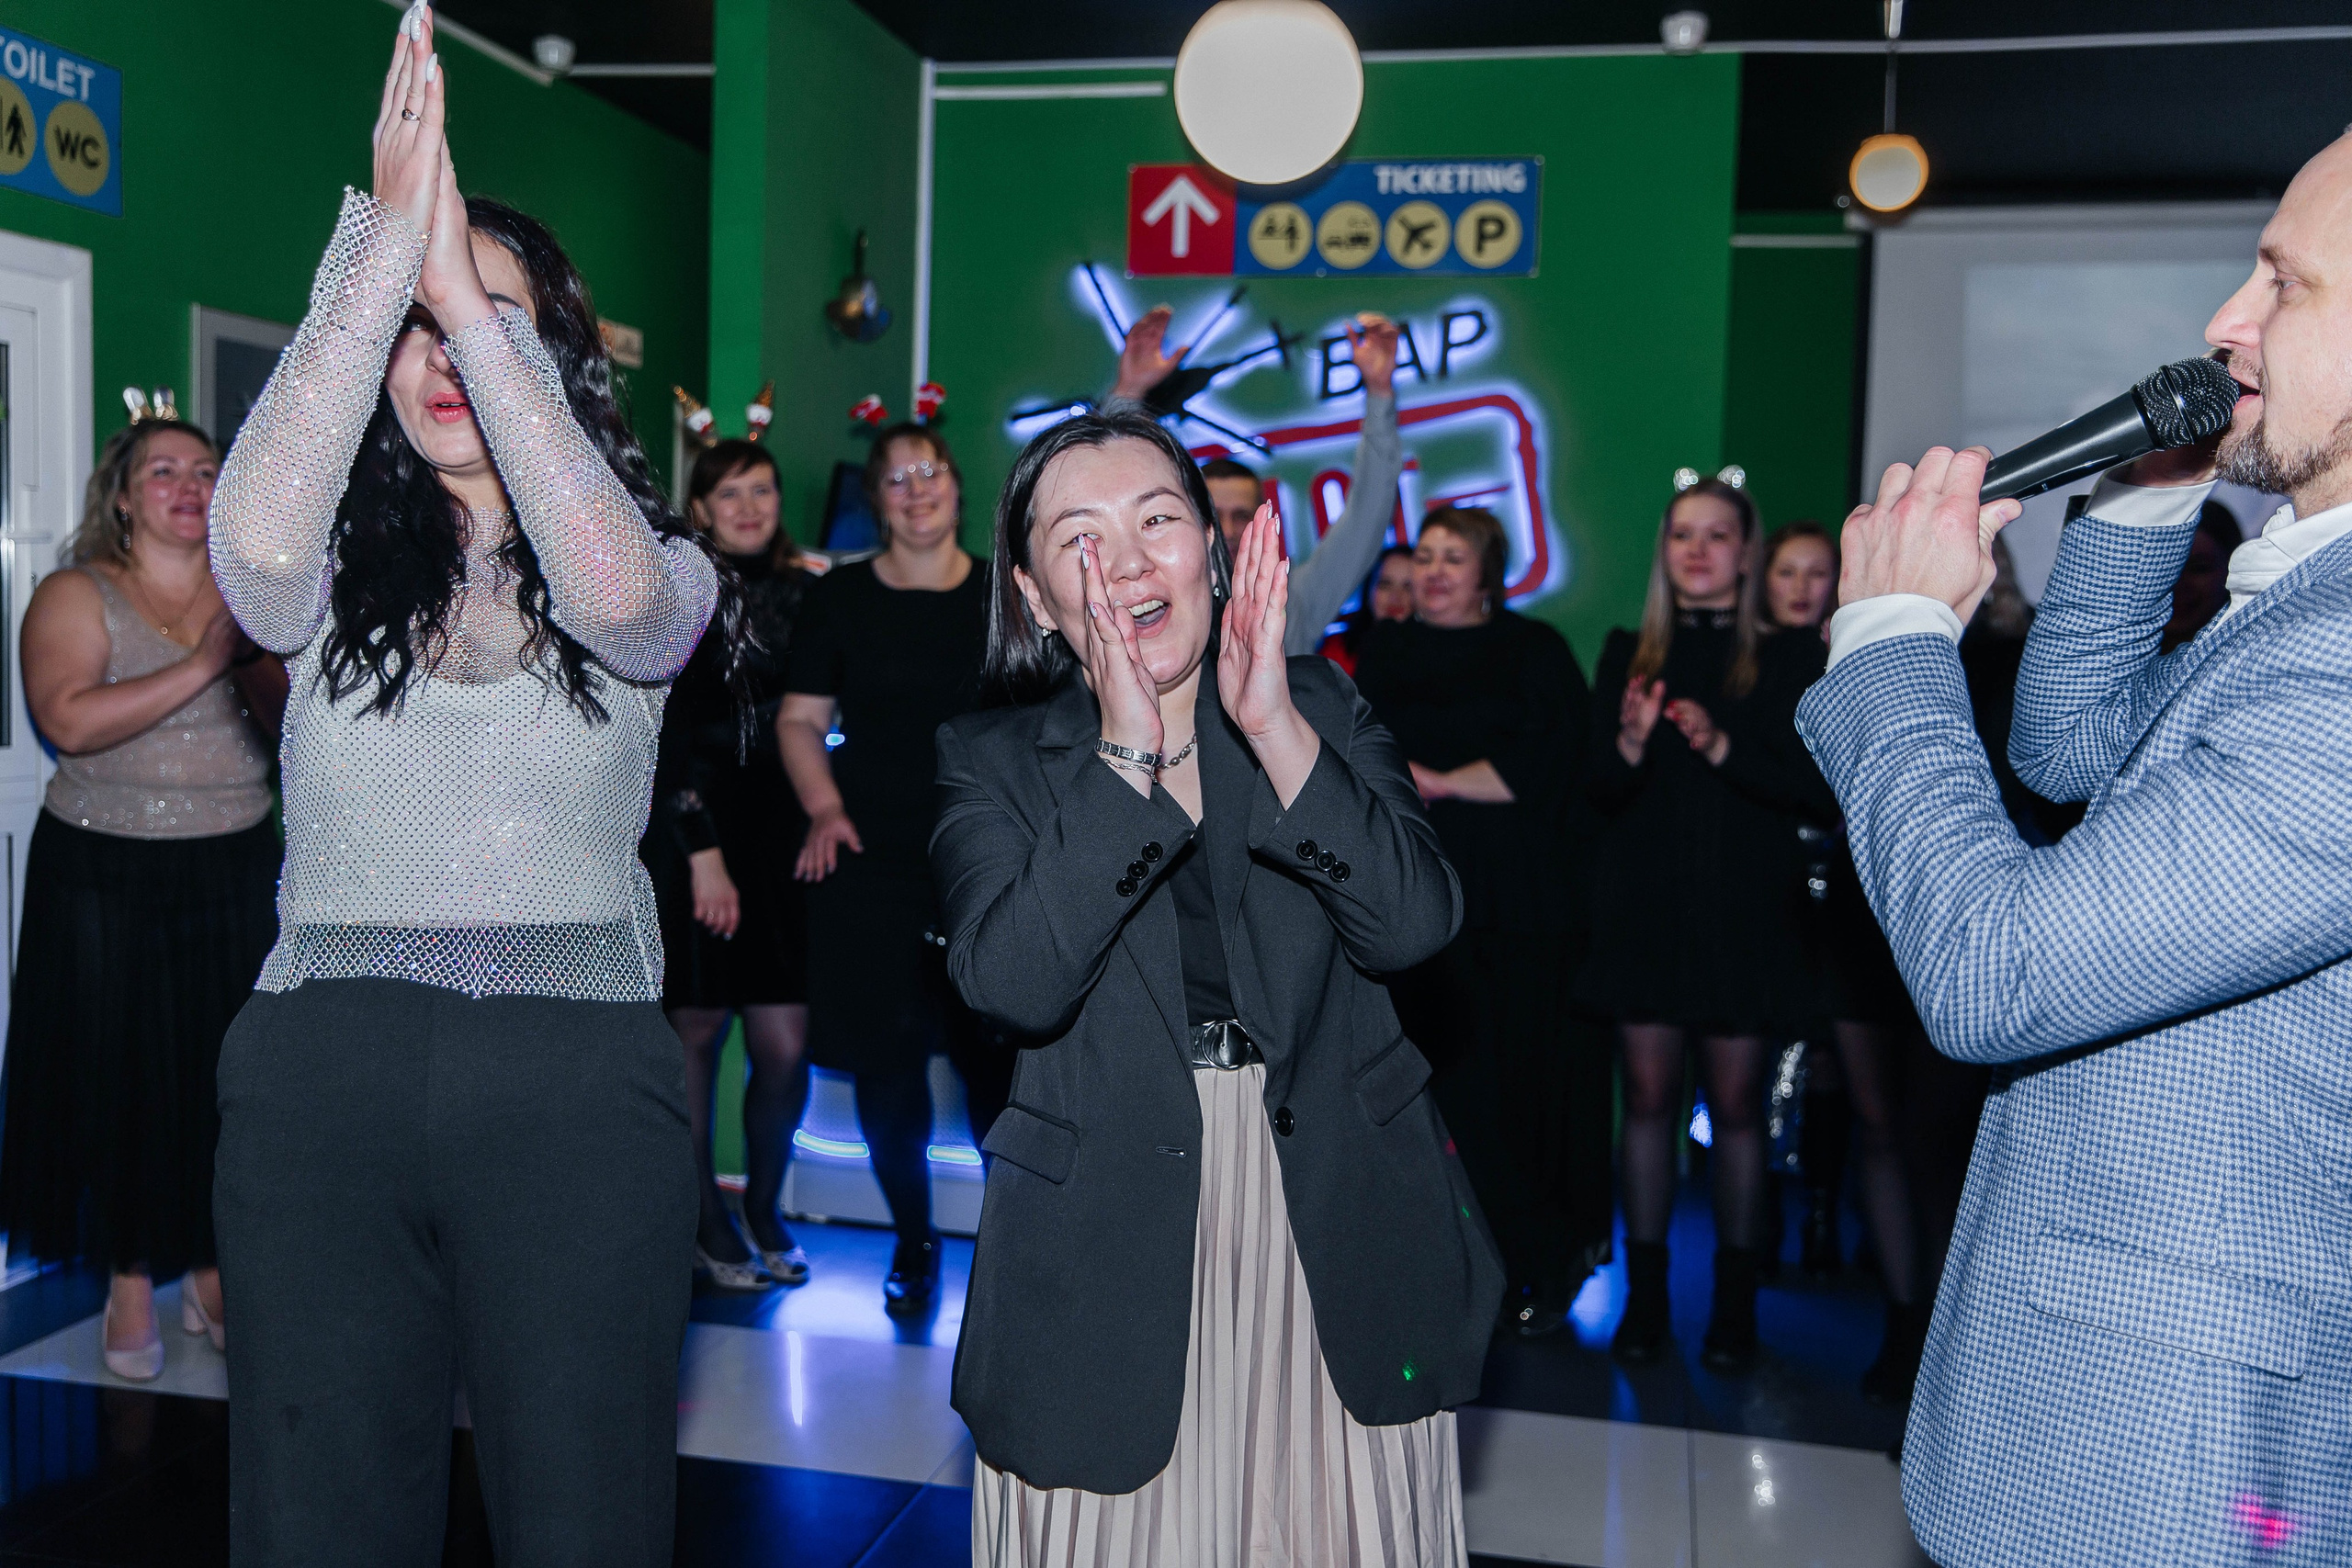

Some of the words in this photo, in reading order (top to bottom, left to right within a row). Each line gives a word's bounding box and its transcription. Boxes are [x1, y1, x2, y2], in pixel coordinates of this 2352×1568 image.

[0, 35, 96, 102] OILET
[53, 125, 102, 171] WC
[1373, 164, 1528, 195] TICKETING
[1476, 214, 1507, 257] P
